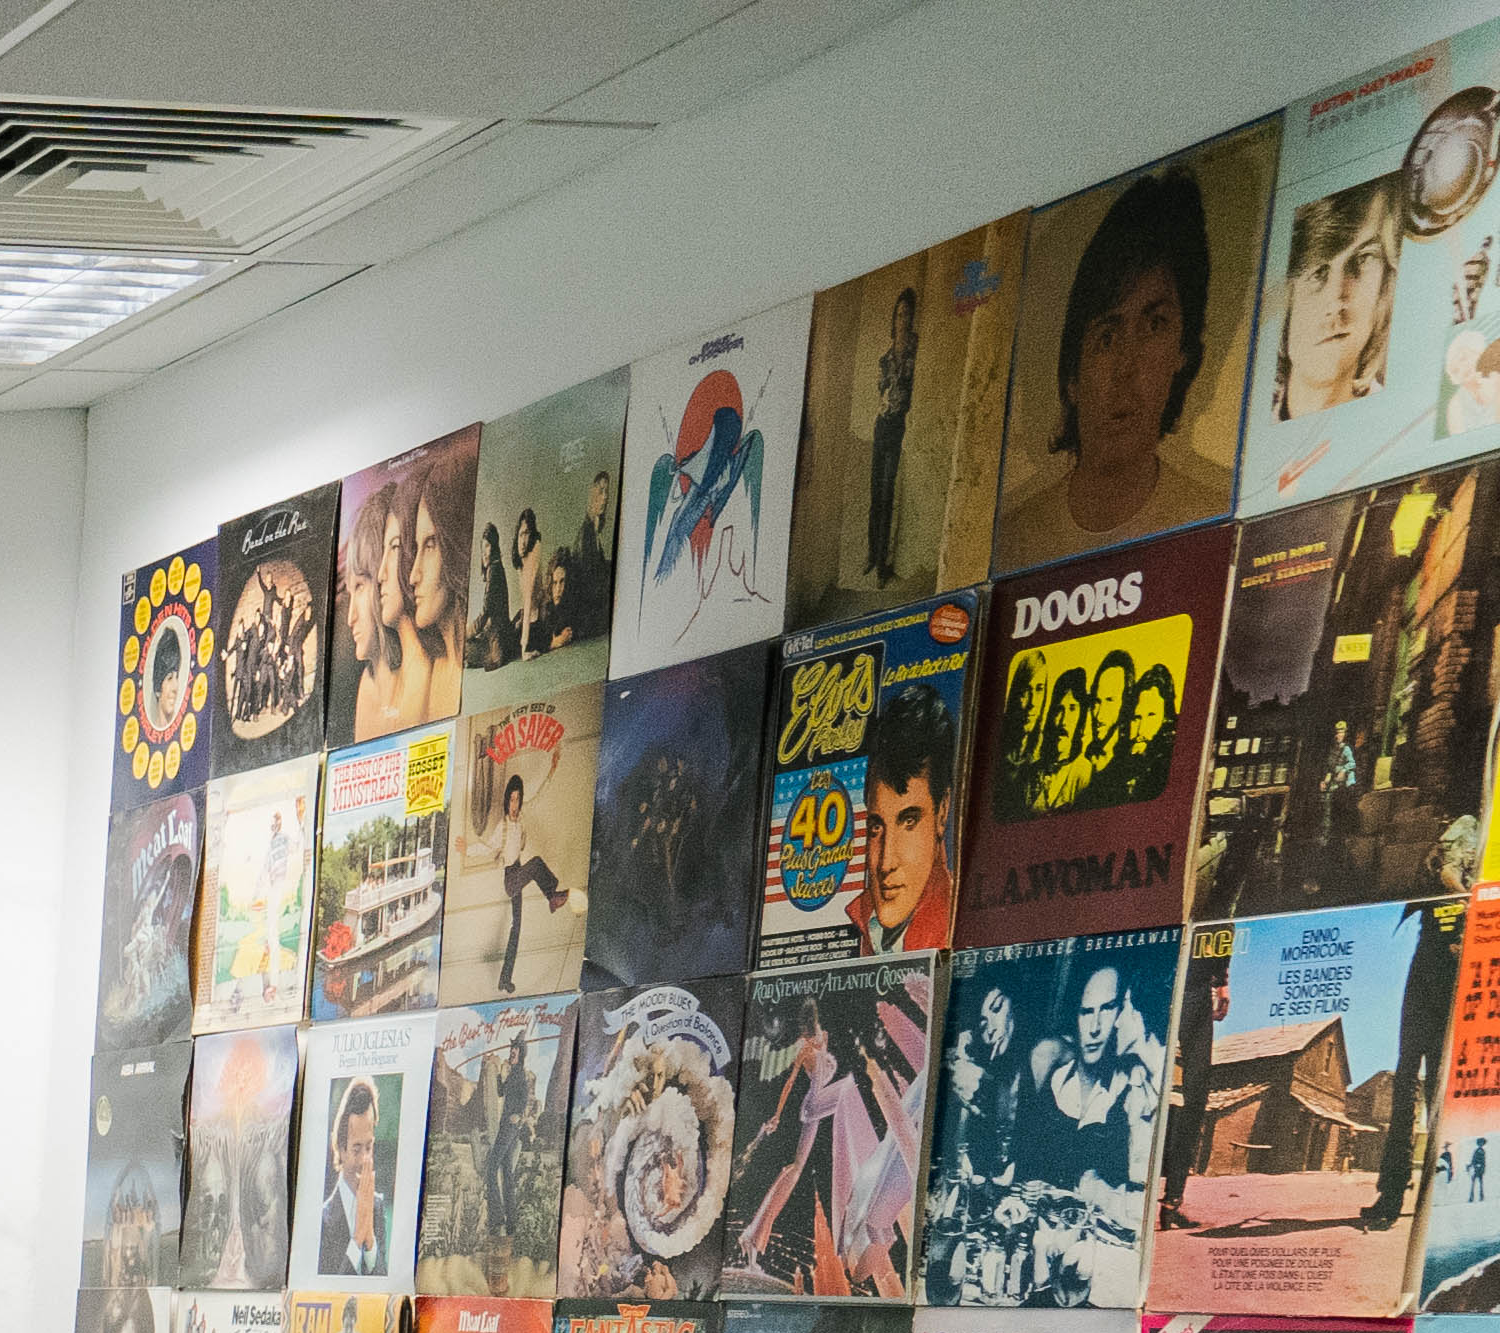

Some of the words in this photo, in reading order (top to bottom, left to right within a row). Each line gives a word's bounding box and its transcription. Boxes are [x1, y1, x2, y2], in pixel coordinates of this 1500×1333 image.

[1253, 550, 1288, 569] DAVID
[1288, 540, 1328, 559] BOWIE
[1011, 571, 1144, 640] DOORS
[529, 702, 546, 713] BEST
[777, 652, 876, 766] Elvis
[486, 723, 516, 766] LEO
[517, 712, 565, 753] SAYER
[351, 759, 373, 781] BEST
[372, 757, 385, 776] OF
[384, 751, 402, 773] THE
[332, 772, 401, 812] MINSTRELS
[790, 790, 848, 850] 40
[984, 937, 1077, 963] GARFUNKEL
[1084, 928, 1181, 952] BREAKAWAY
[1192, 928, 1250, 959] RCA
[1280, 940, 1356, 961] MORRICONE
[1301, 927, 1341, 946] ENNIO
[752, 980, 774, 1006] ROD
[772, 978, 821, 1004] STEWART
[818, 972, 876, 1000] ATLANTIC
[1277, 969, 1303, 987] LES
[1304, 965, 1353, 985] BANDES
[1283, 982, 1343, 1000] SONORES
[620, 1006, 637, 1023] THE
[638, 996, 669, 1013] MOODY
[667, 995, 693, 1011] BLUES
[1268, 1001, 1286, 1018] DE
[1286, 1000, 1312, 1017] SES
[1312, 997, 1351, 1015] FILMS
[361, 1026, 413, 1051] IGLESIAS
[1271, 1247, 1308, 1257] DOLLARS
[1298, 1259, 1334, 1269] DOLLARS
[231, 1304, 250, 1326] Neil
[250, 1304, 282, 1327] Sedaka
